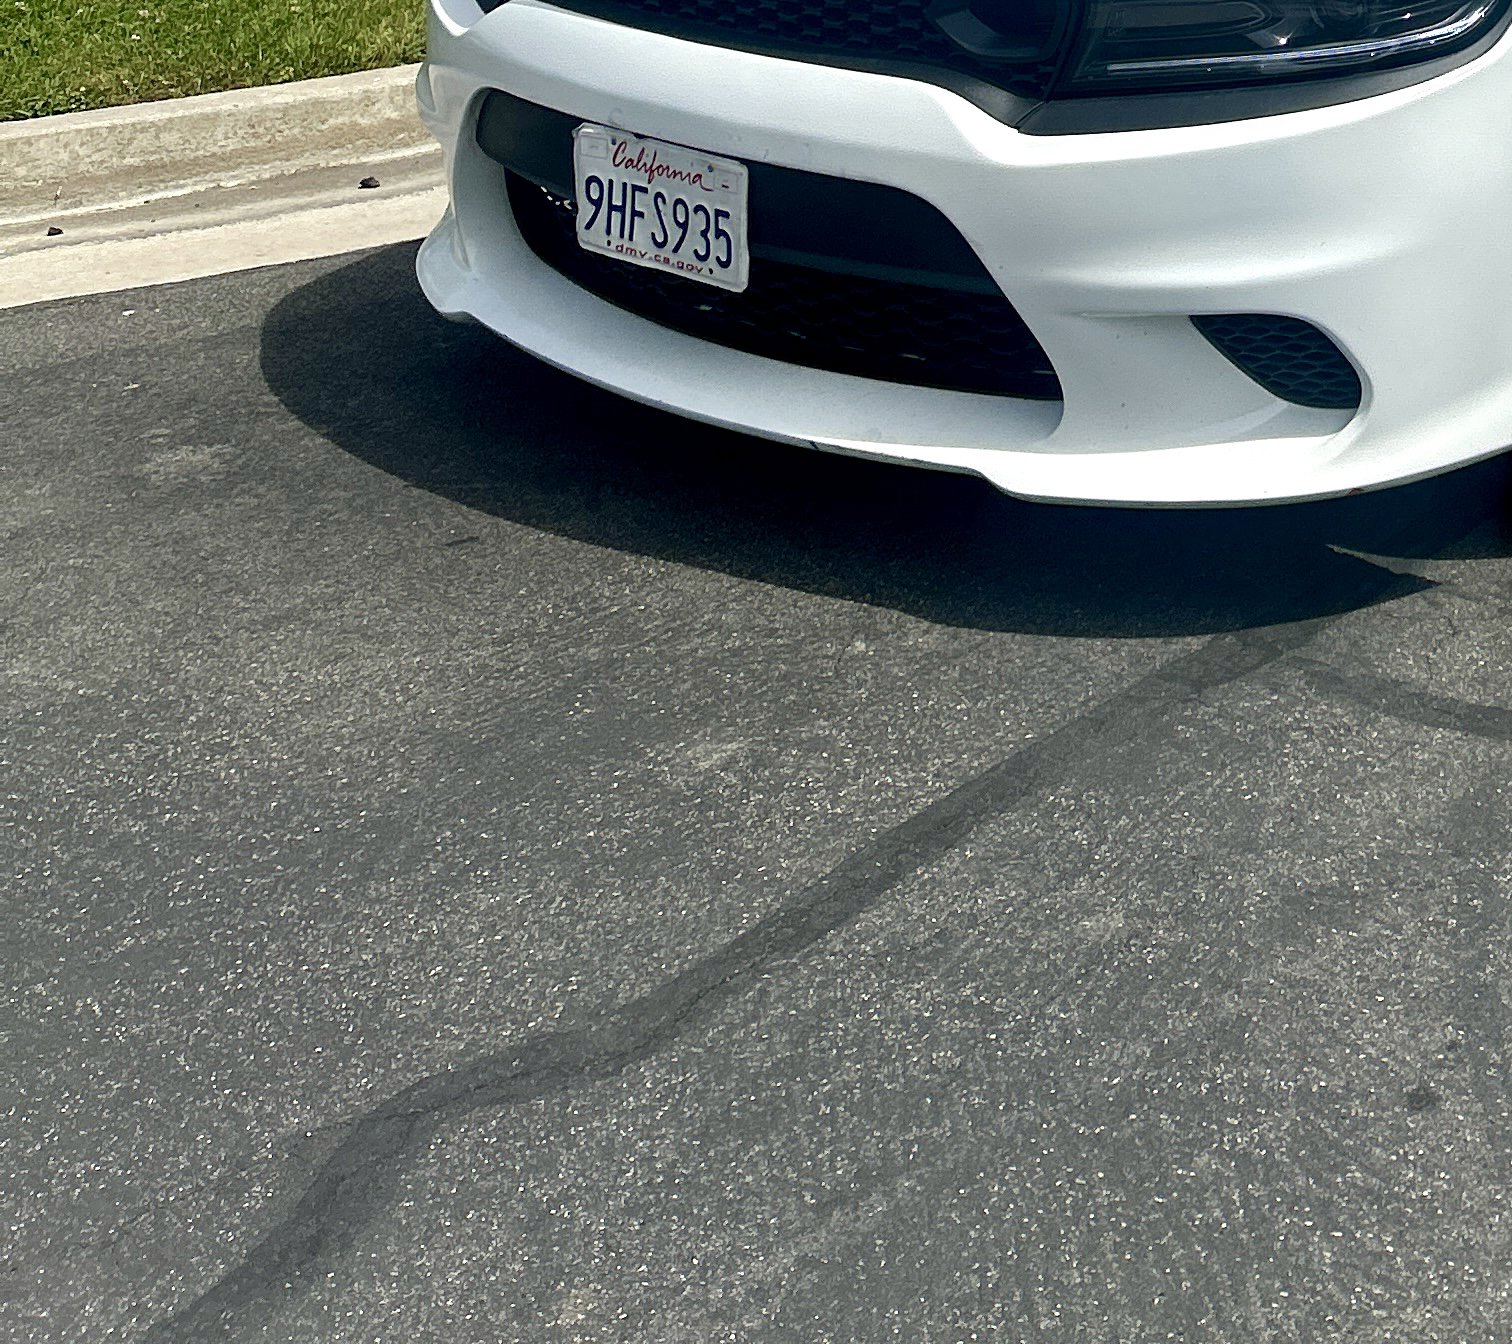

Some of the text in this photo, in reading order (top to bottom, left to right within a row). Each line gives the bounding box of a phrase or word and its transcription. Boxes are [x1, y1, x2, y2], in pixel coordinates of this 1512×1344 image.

[611, 140, 714, 192] California
[583, 174, 733, 270] 9HFS935
[615, 242, 704, 275] dmv.ca.gov
